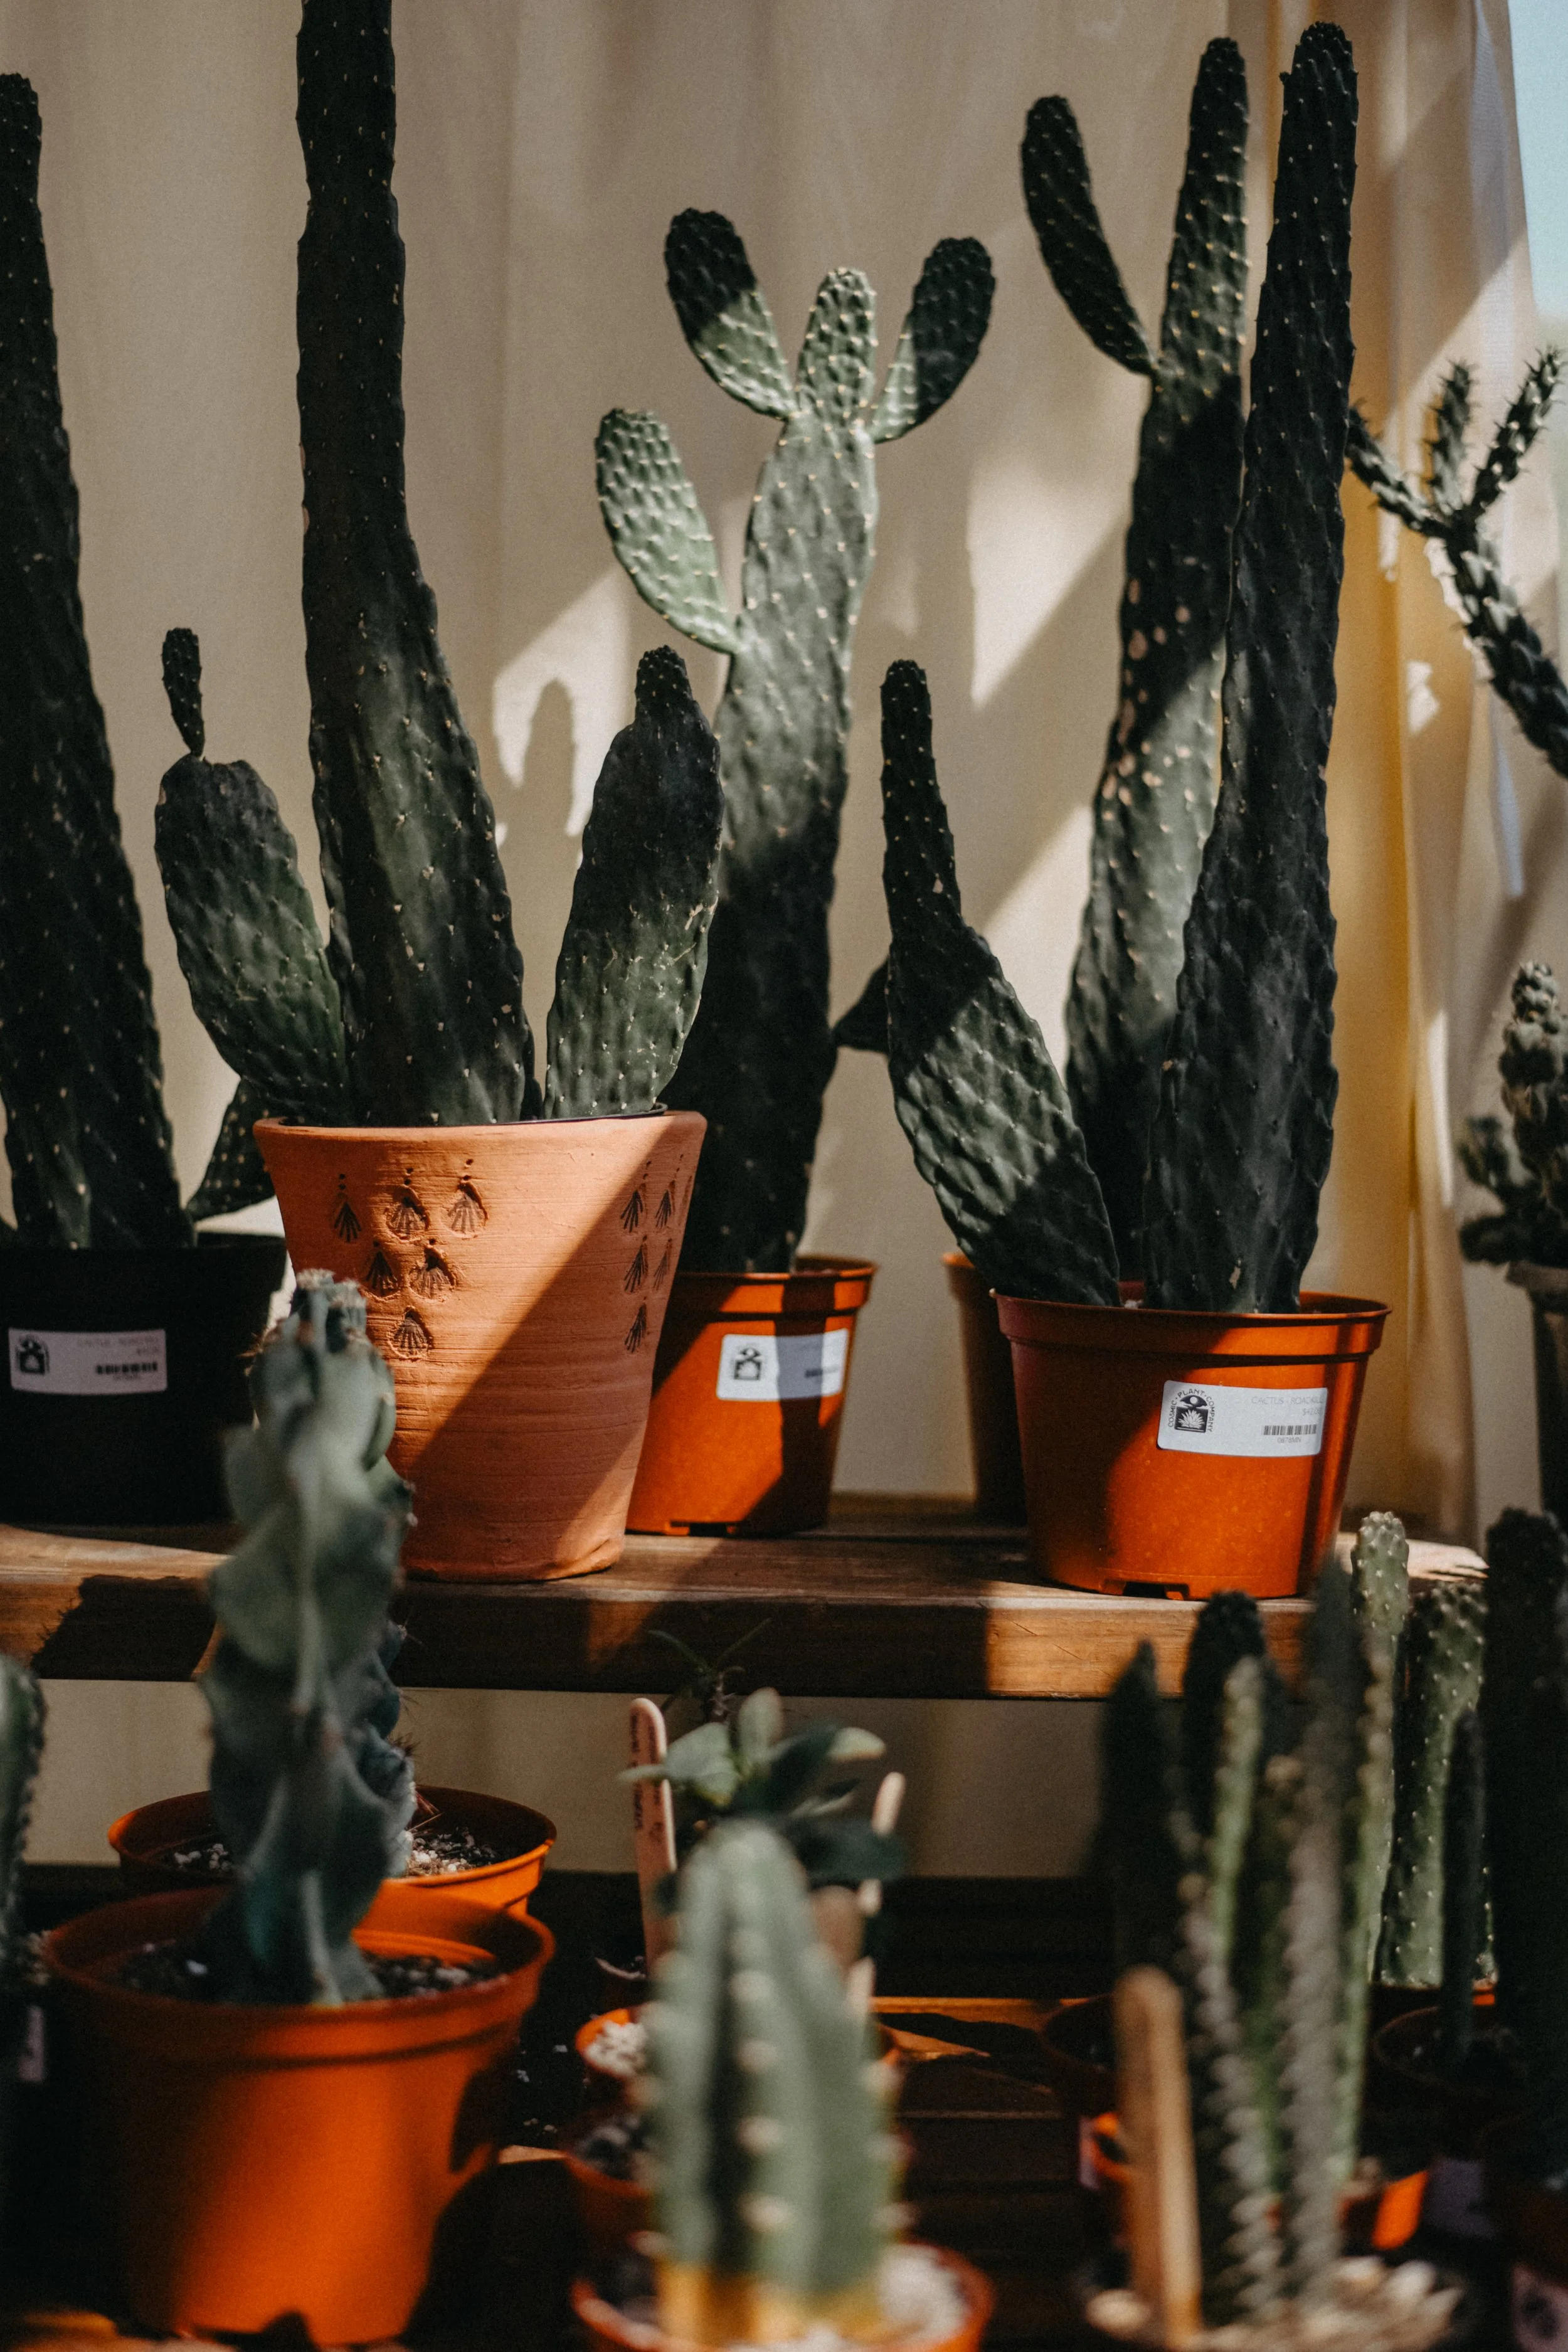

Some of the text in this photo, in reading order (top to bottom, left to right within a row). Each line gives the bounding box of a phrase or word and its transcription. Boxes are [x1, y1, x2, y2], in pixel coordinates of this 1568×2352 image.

[1168, 1389, 1215, 1433] COSMIC PLANT COMPANY
[1251, 1396, 1284, 1404] CACTUS
